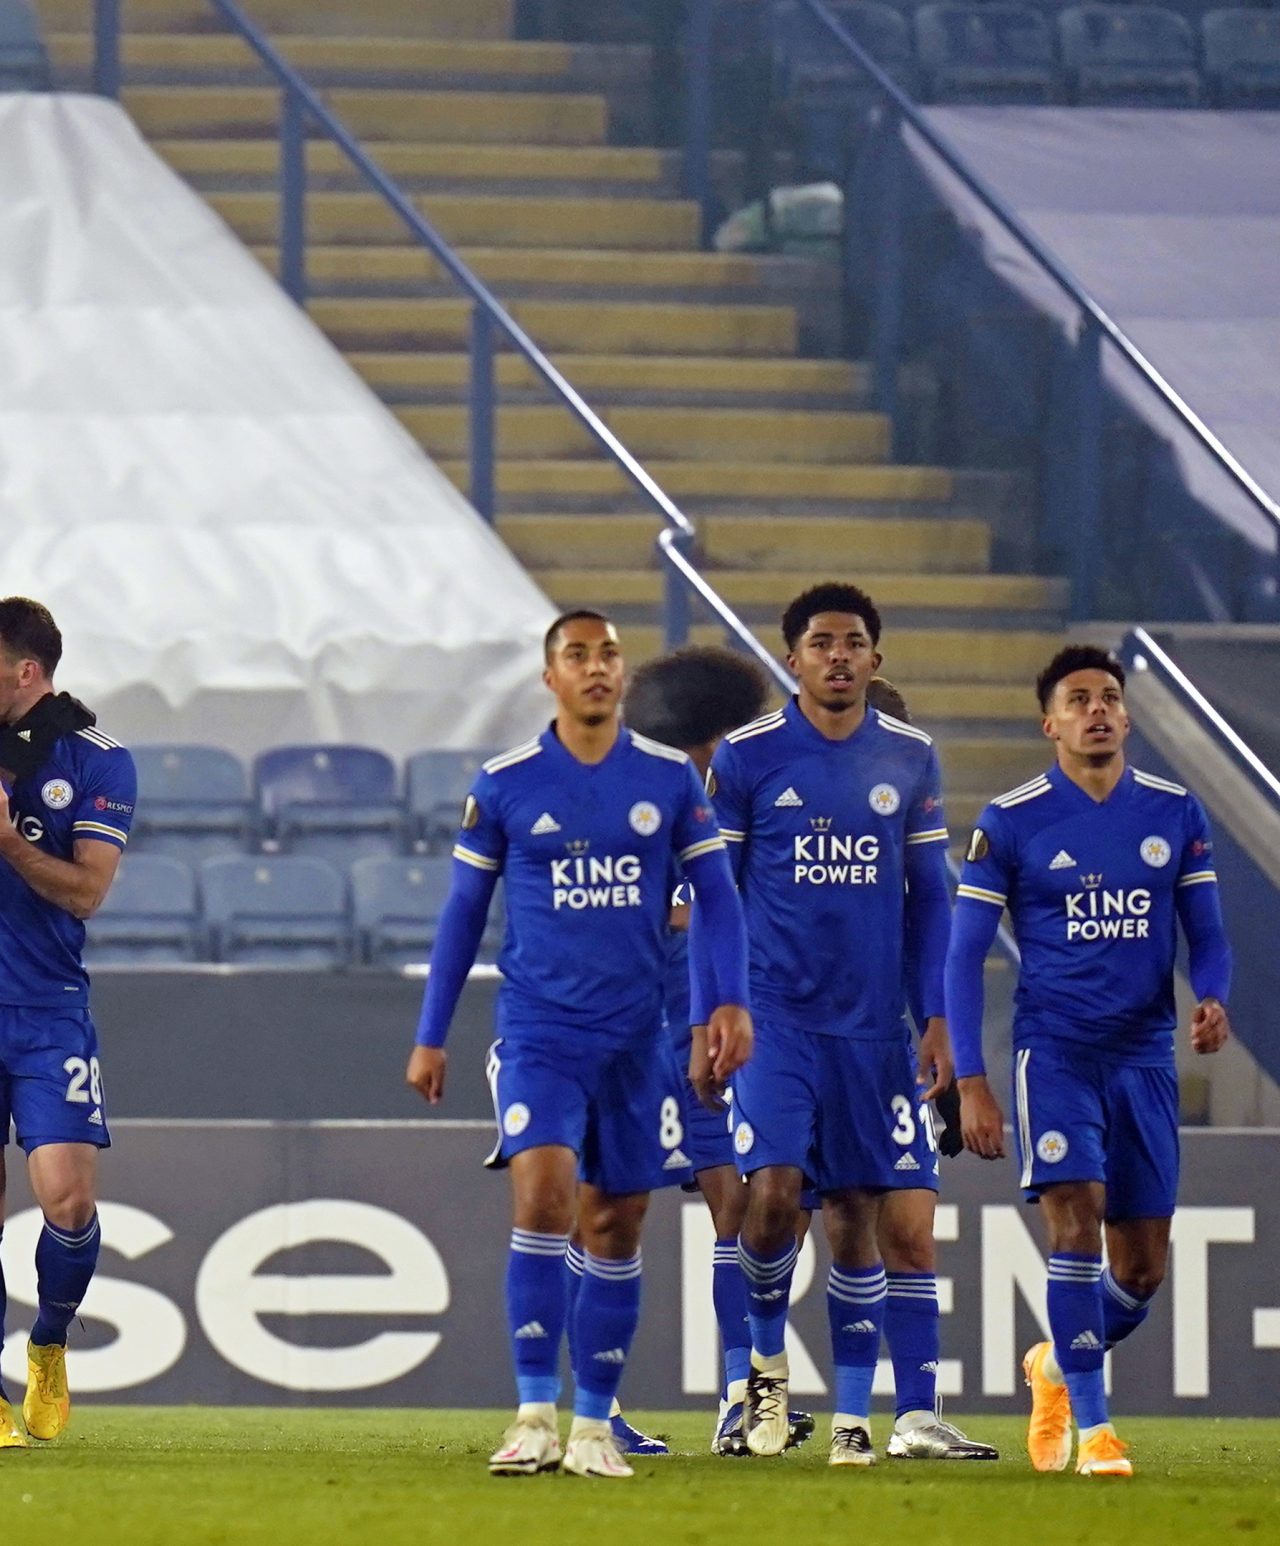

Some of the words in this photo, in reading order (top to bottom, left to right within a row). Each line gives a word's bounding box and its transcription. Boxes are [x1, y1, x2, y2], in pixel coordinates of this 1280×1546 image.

[794, 835, 880, 862] KING
[550, 854, 642, 887] KING
[794, 864, 878, 885] POWER
[553, 884, 642, 911] POWER
[1065, 888, 1152, 918] KING
[1067, 918, 1150, 941] POWER
[62, 1056, 102, 1105] 28
[659, 1095, 684, 1150] 8
